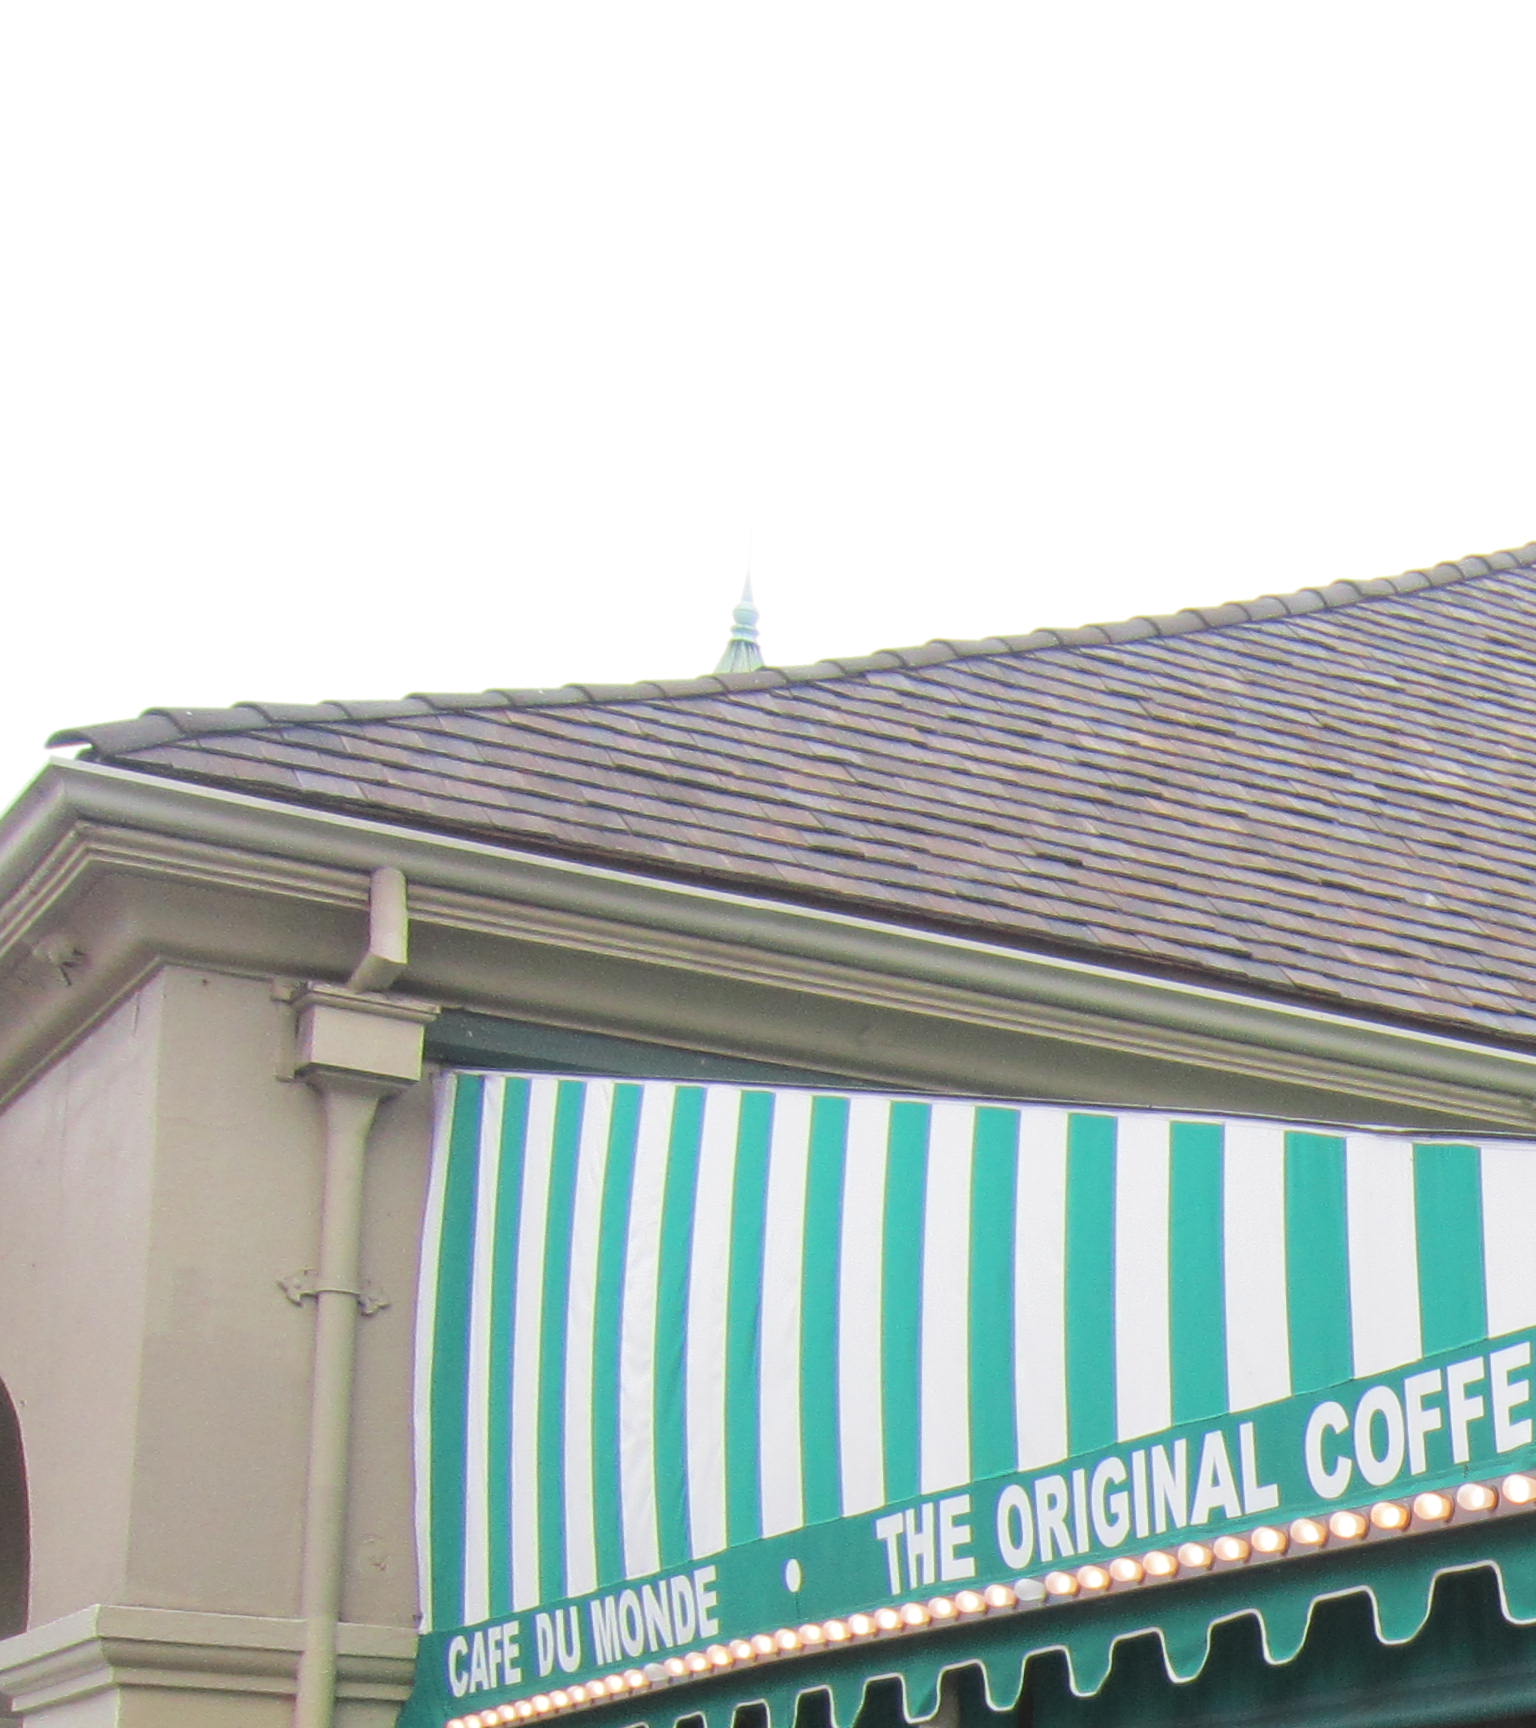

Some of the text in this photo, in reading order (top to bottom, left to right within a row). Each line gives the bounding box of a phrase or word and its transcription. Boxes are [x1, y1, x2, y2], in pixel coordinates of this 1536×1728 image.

[448, 1620, 522, 1698] CAFE
[535, 1606, 582, 1677] DU
[590, 1565, 720, 1667] MONDE
[875, 1494, 977, 1595] THE
[997, 1421, 1279, 1569] ORIGINAL
